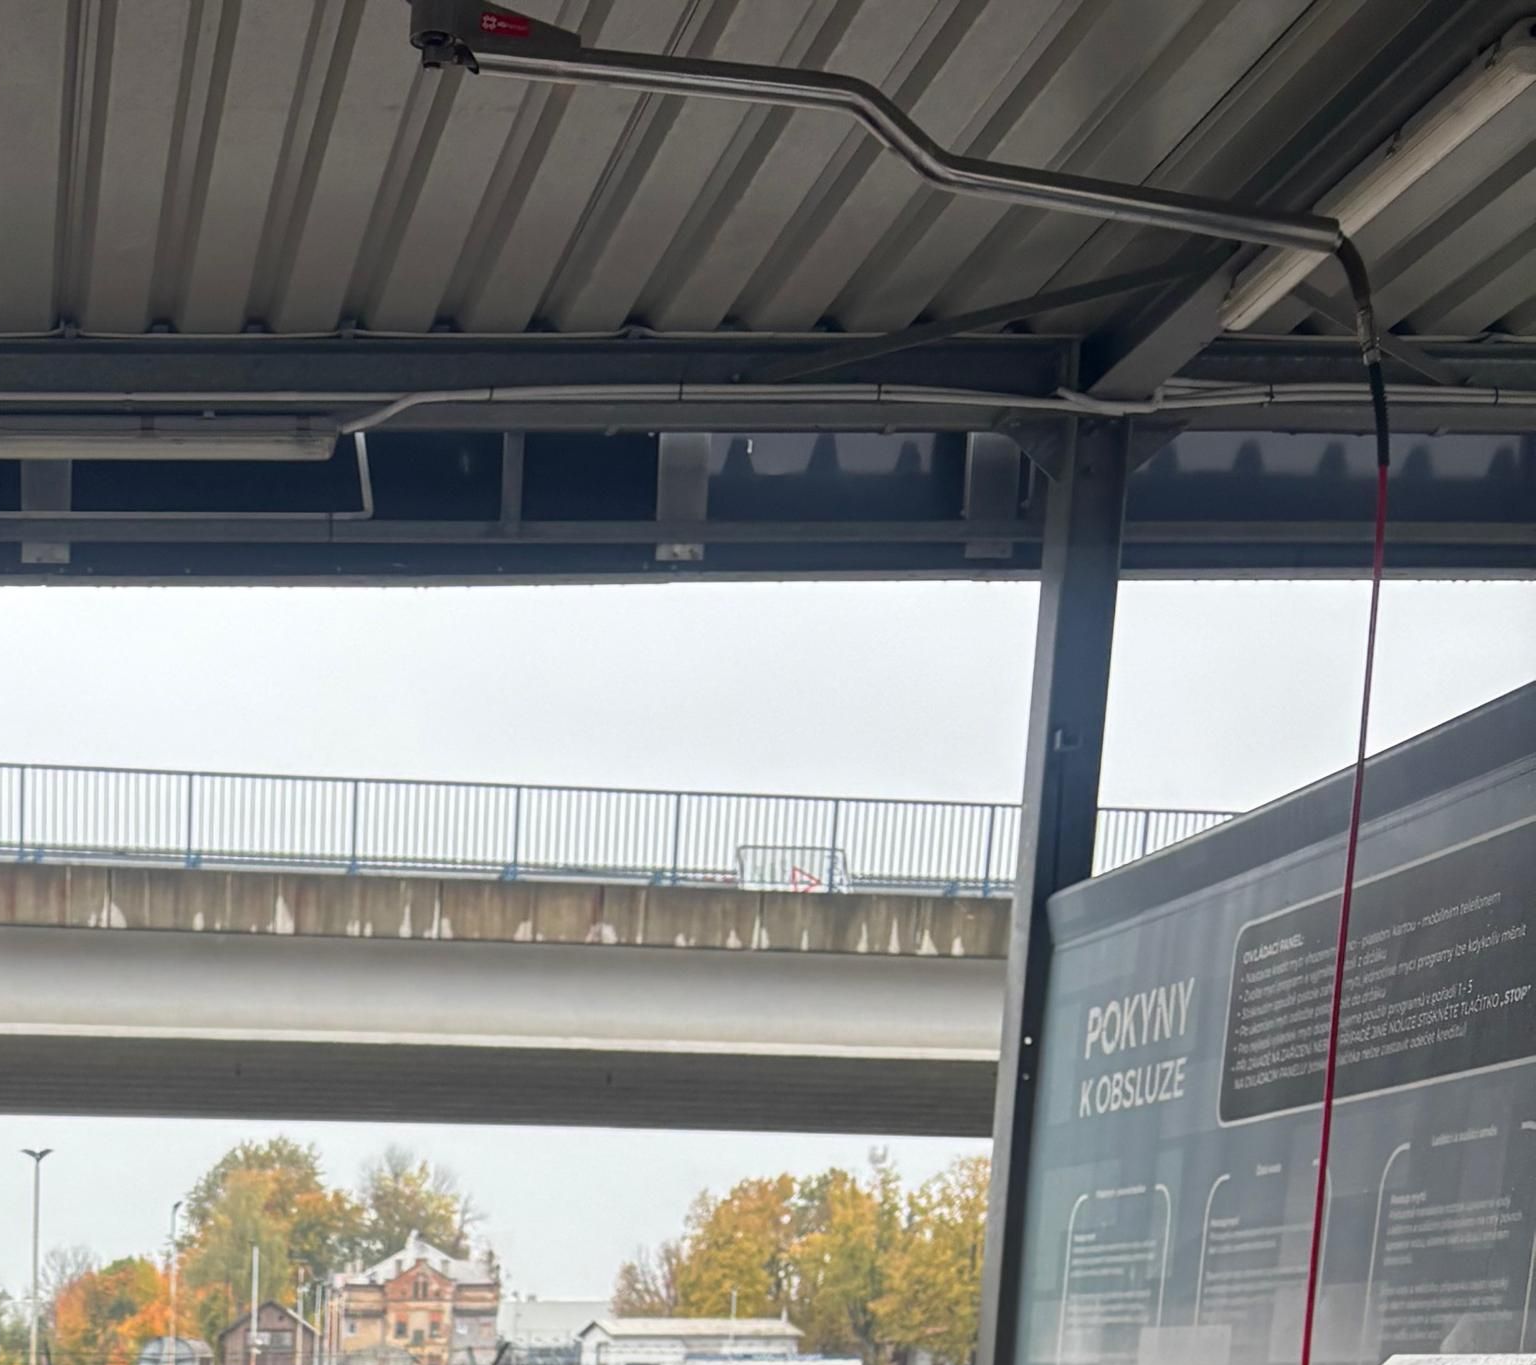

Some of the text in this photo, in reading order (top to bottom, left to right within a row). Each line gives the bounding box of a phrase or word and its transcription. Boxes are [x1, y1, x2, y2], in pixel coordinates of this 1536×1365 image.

[1084, 976, 1195, 1060] POKYNY
[1079, 1057, 1188, 1118] K OBSLUZE
